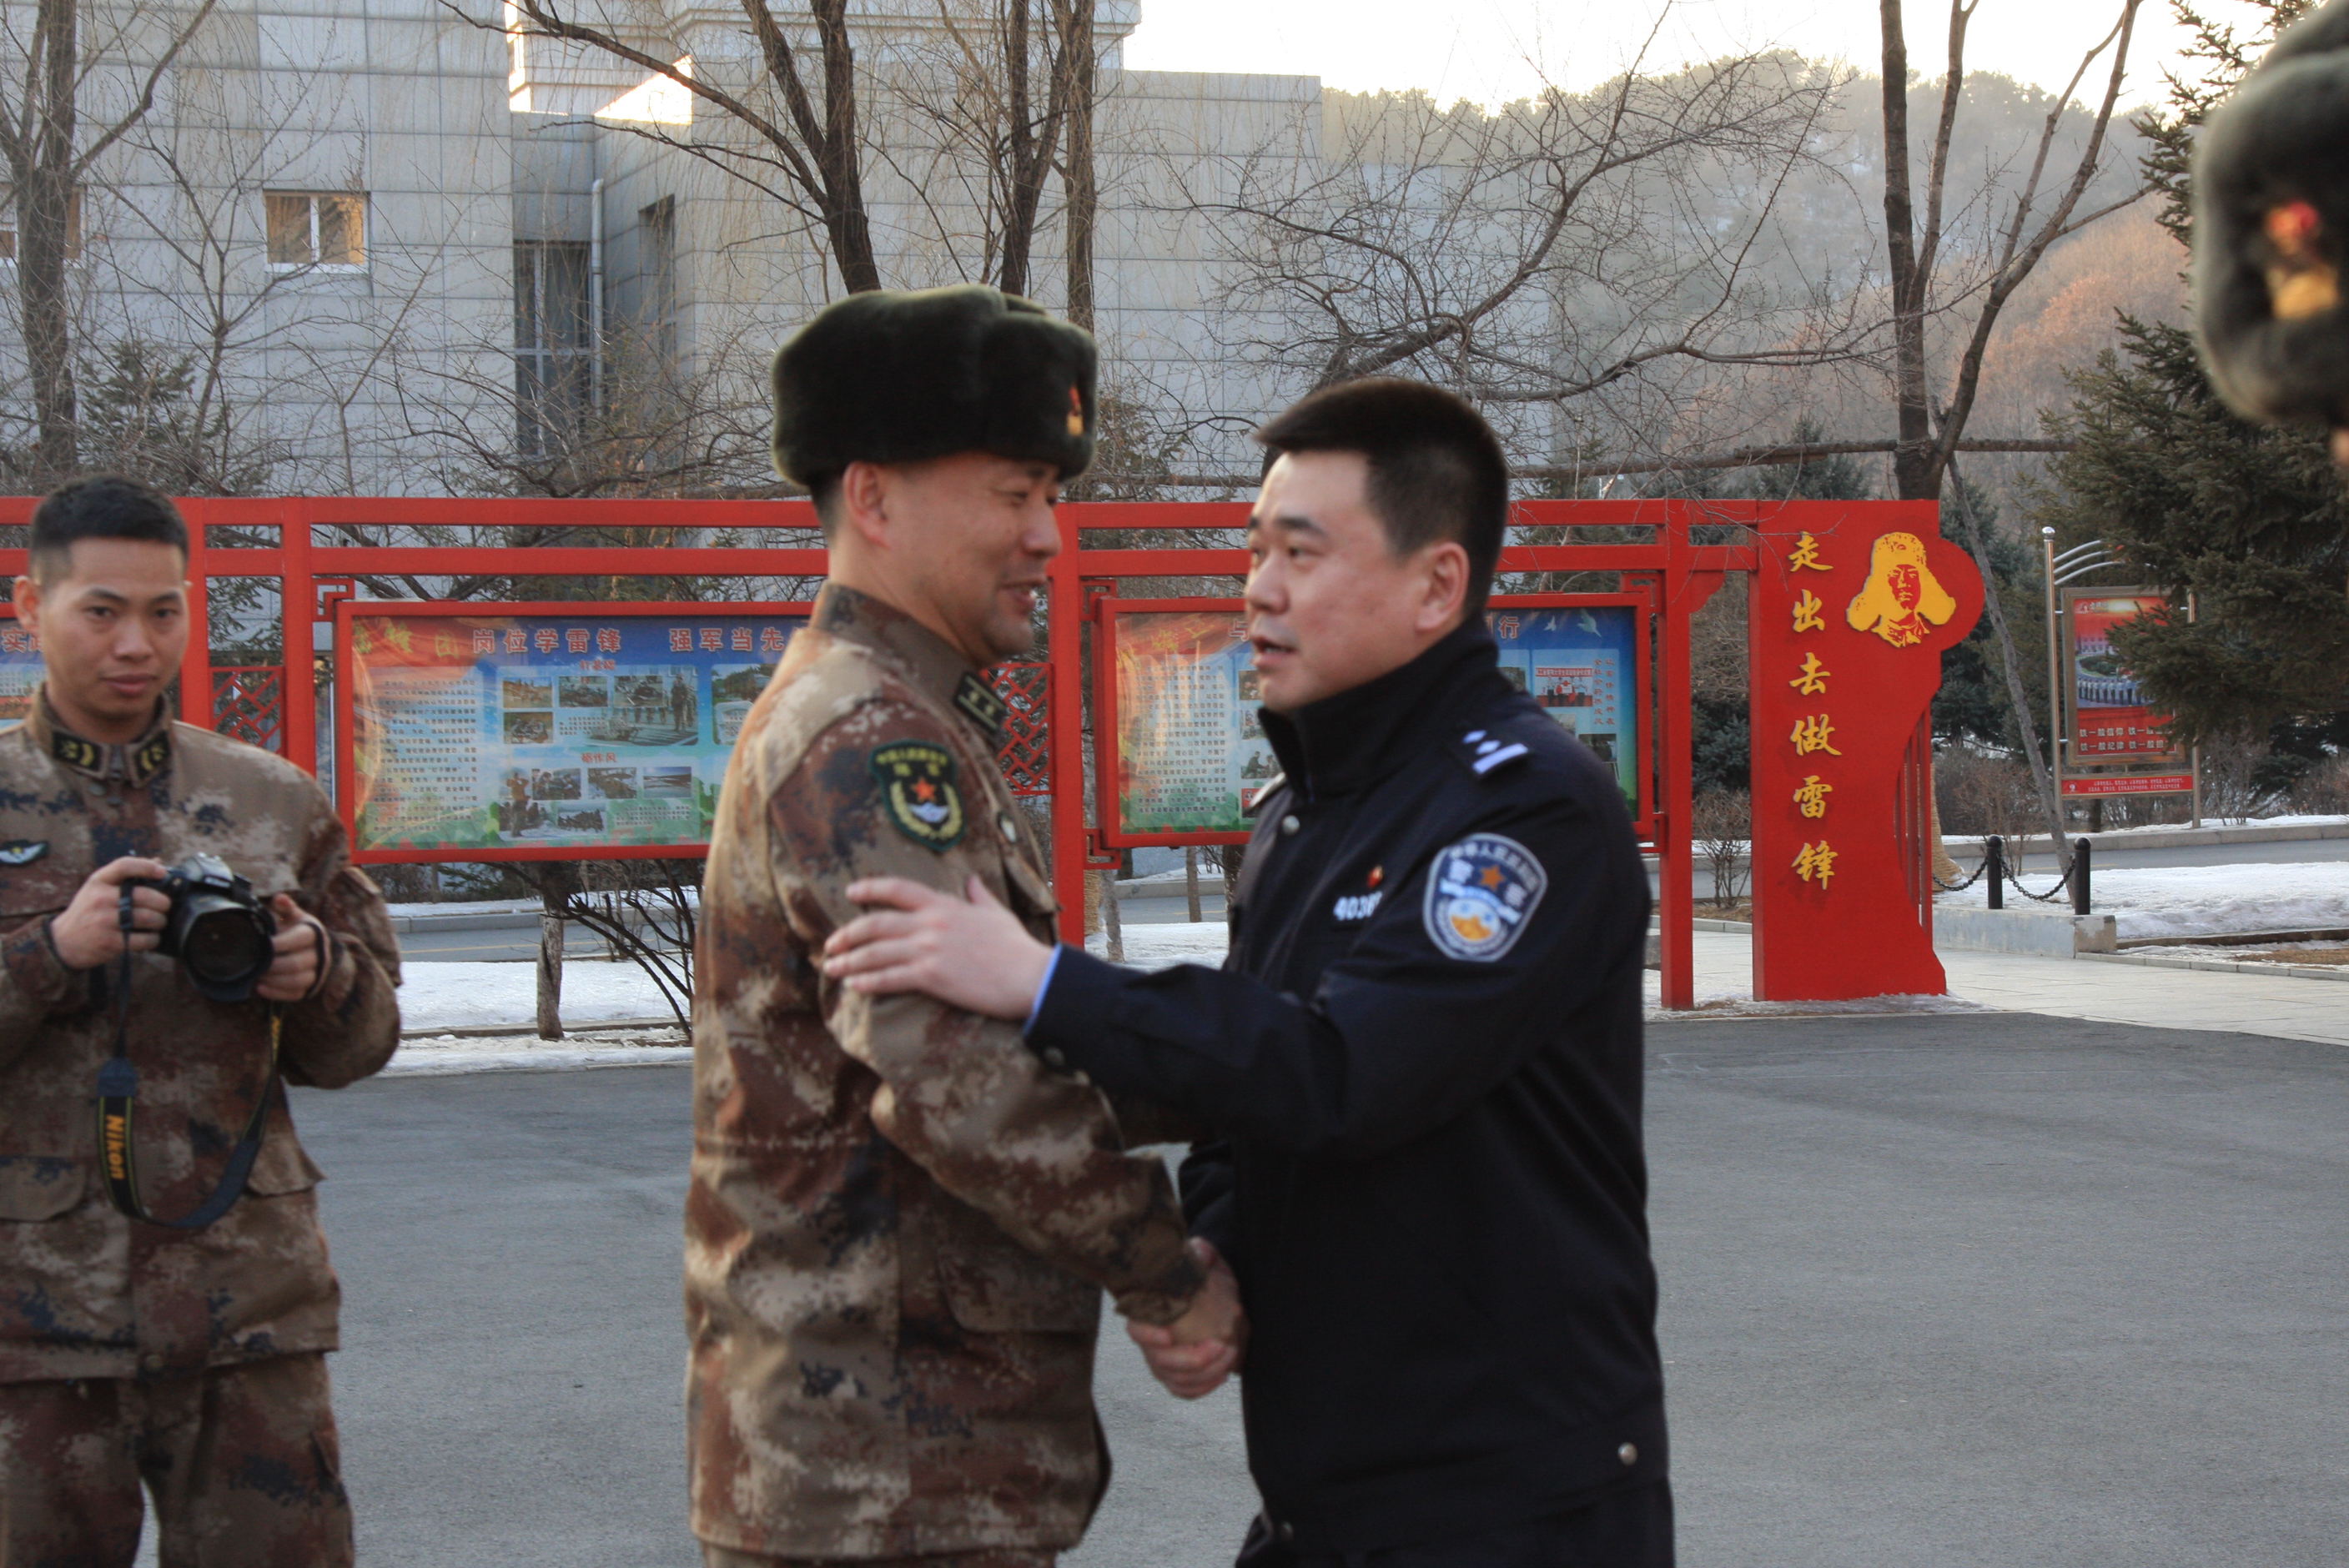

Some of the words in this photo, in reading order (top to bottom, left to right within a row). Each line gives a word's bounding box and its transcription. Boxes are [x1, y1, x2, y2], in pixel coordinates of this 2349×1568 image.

[473, 628, 621, 654] 岗位学雷锋
[1788, 530, 1842, 890] 走出去做雷锋
[2129, 739, 2168, 750] 铁一般担
[105, 1114, 125, 1180] Nikon
